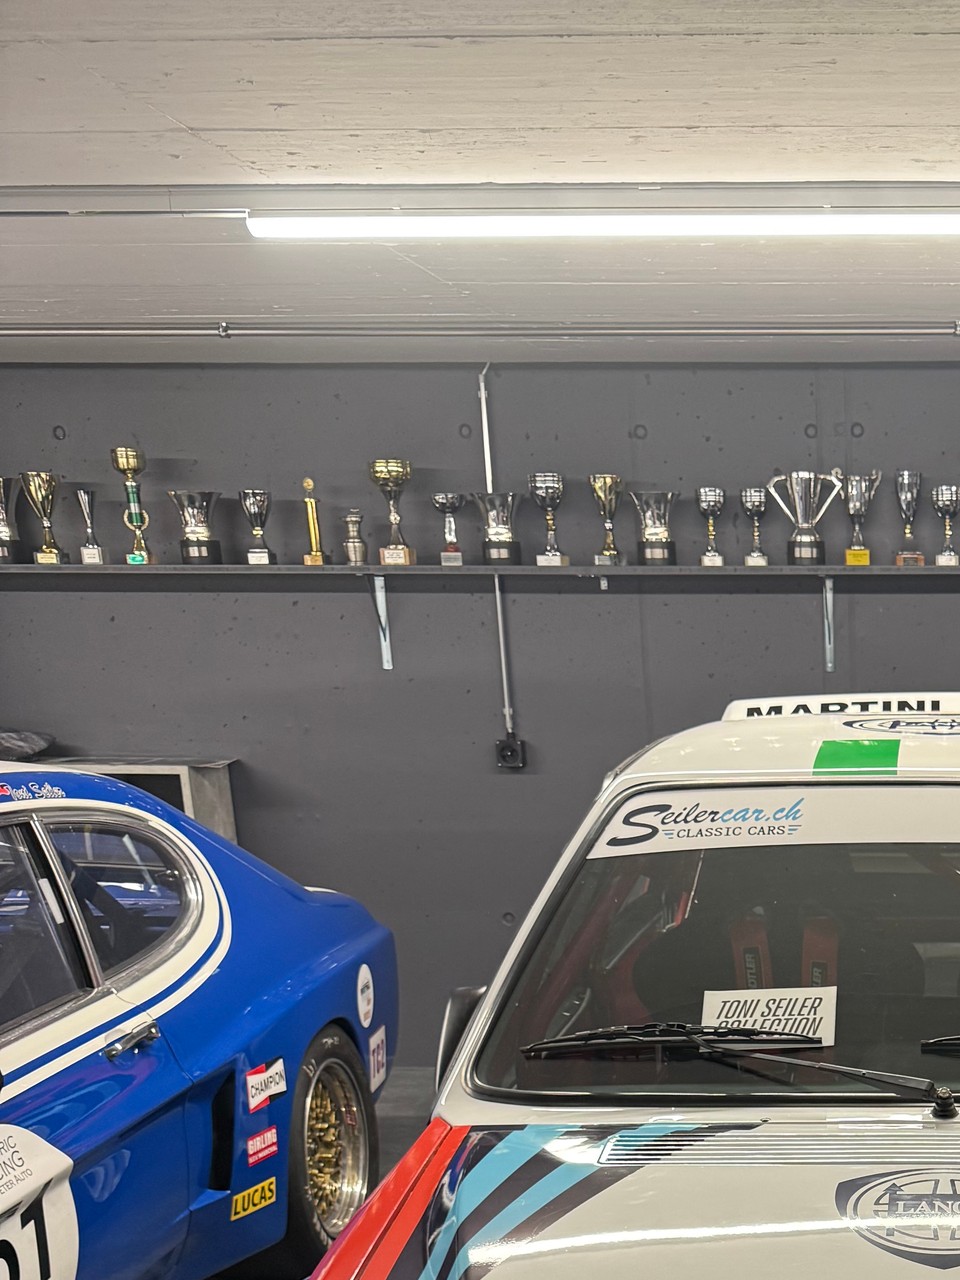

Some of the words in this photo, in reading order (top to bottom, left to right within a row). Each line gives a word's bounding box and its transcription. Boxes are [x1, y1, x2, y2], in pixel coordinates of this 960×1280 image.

[606, 798, 805, 846] Seilercar.ch
[676, 826, 742, 838] CLASSIC
[747, 825, 786, 836] CARS
[716, 998, 761, 1020] TONI
[761, 997, 823, 1018] SEILER
[250, 1069, 285, 1099] CHAMPION
[0, 1150, 25, 1181] ING
[233, 1181, 274, 1216] LUCAS
